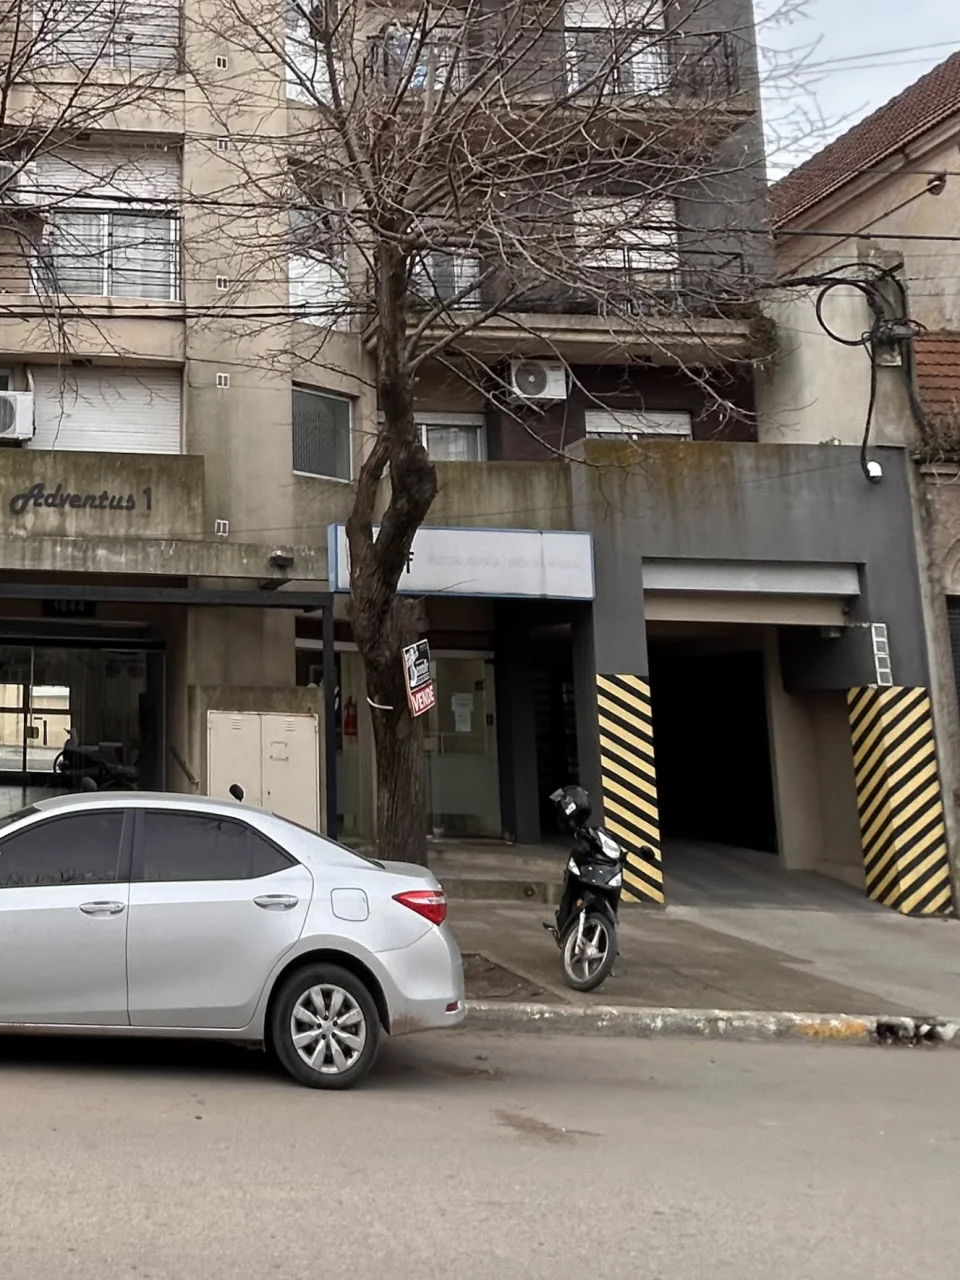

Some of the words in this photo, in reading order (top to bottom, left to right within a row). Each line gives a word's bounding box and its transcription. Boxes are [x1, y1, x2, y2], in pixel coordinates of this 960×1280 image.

[10, 483, 136, 515] Adventus
[143, 486, 152, 510] 1
[411, 685, 435, 711] VENDE
